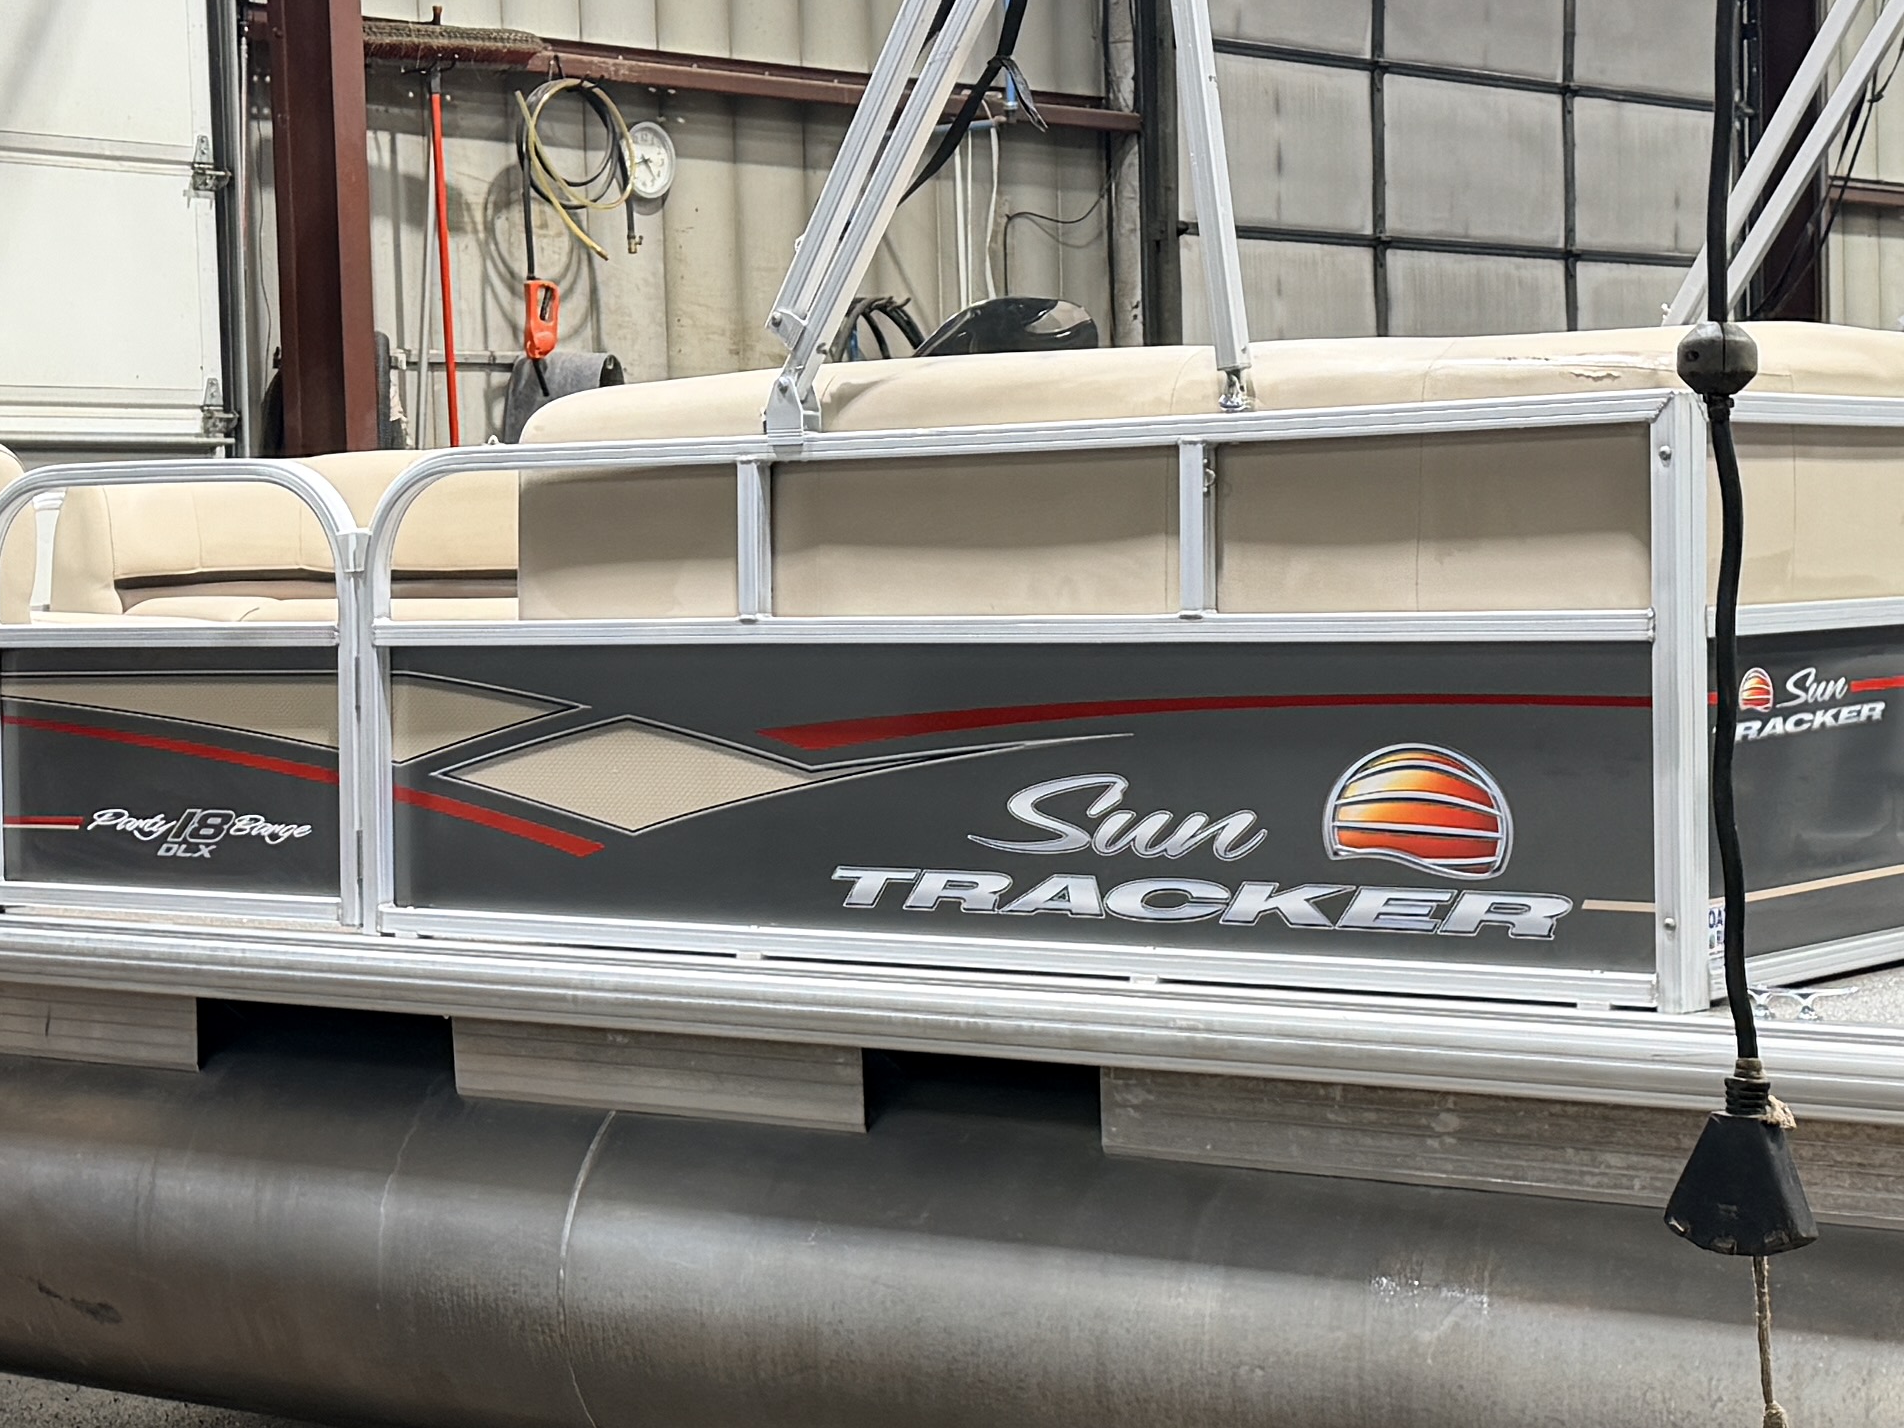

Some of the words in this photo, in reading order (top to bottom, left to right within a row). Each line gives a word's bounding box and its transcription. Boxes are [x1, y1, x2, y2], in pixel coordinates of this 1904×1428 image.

[1776, 667, 1849, 709] Sun
[1712, 701, 1886, 744] RACKER
[87, 808, 177, 841] Party
[167, 808, 235, 843] 18
[229, 814, 313, 845] Barge
[967, 772, 1268, 862] Sun
[157, 843, 217, 858] DLX
[832, 865, 1573, 940] TRACKER
